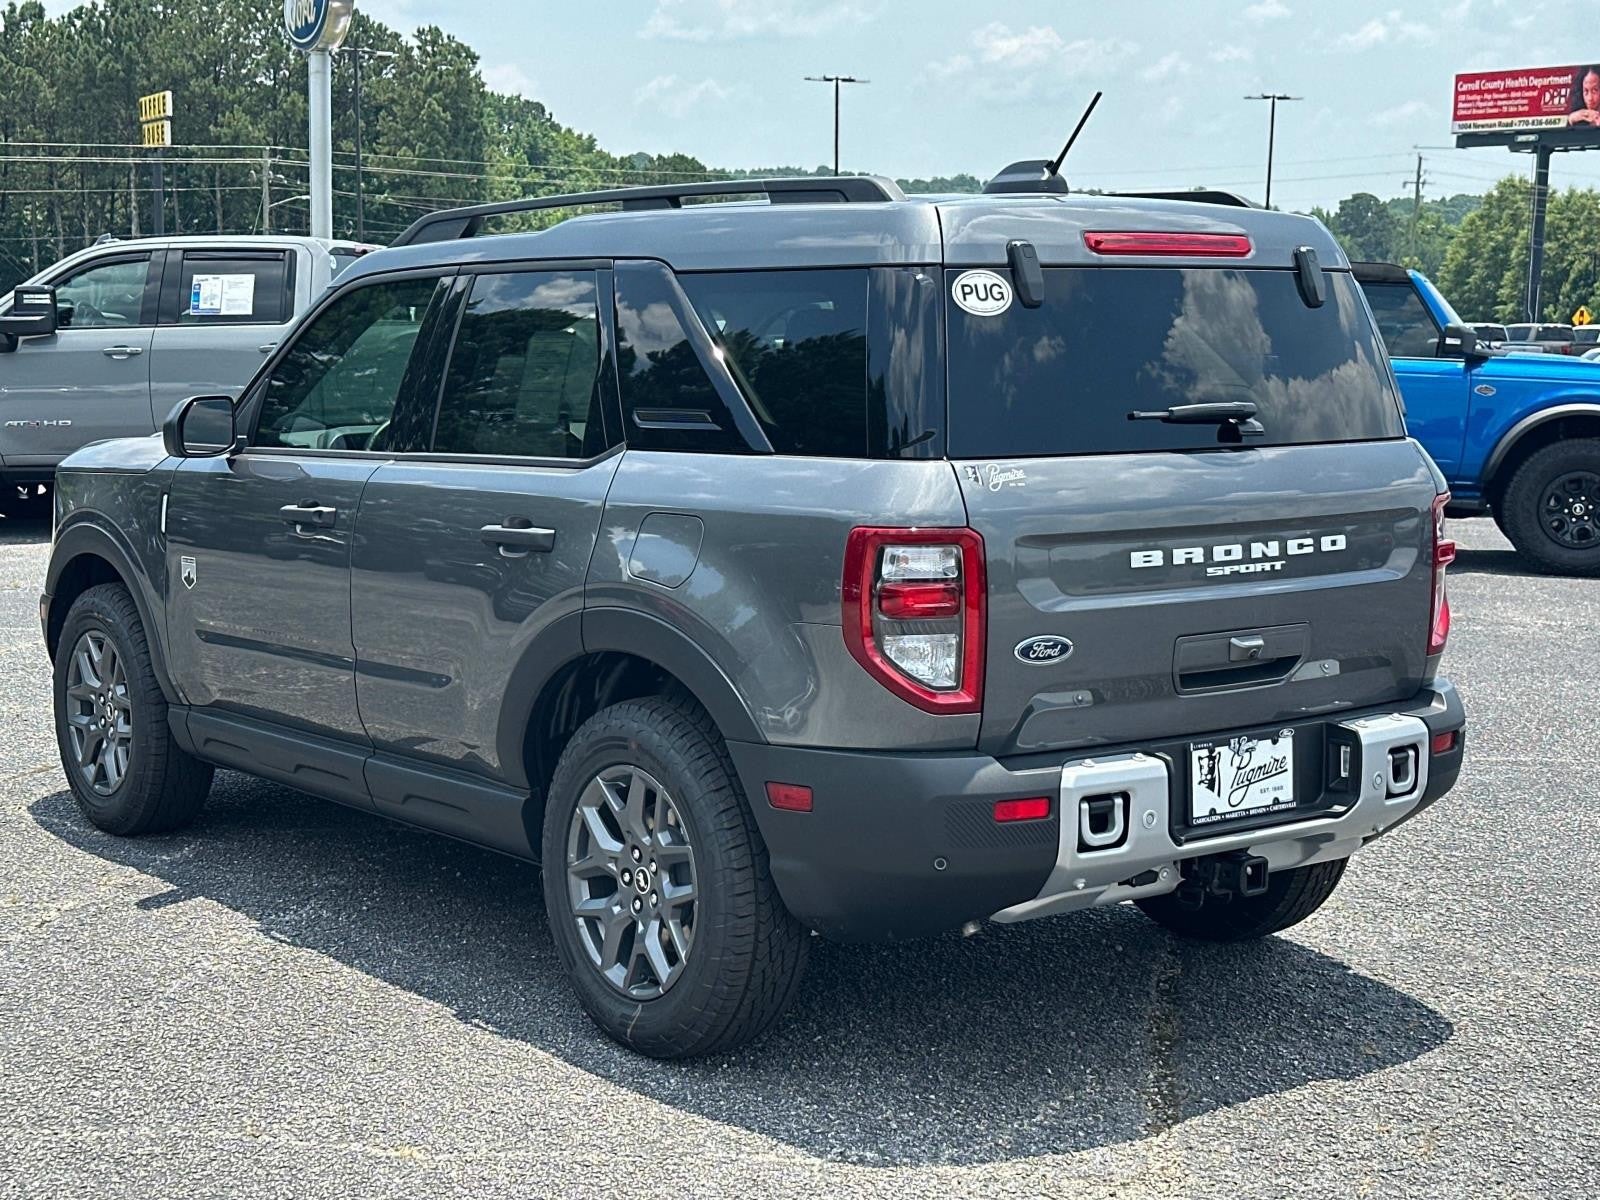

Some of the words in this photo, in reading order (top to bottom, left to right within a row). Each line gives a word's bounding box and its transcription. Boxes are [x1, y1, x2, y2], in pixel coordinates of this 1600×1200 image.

[1458, 80, 1479, 91] Carroll
[1480, 78, 1504, 91] County
[1505, 77, 1528, 88] Health
[1529, 74, 1572, 88] Department
[1498, 120, 1513, 128] Road
[960, 283, 1005, 302] PUG
[986, 463, 1026, 492] Pugmire
[1130, 534, 1347, 568] BRONCO
[1206, 560, 1286, 577] SPORT
[1029, 641, 1062, 658] Ford
[1228, 749, 1288, 808] Pugmire
